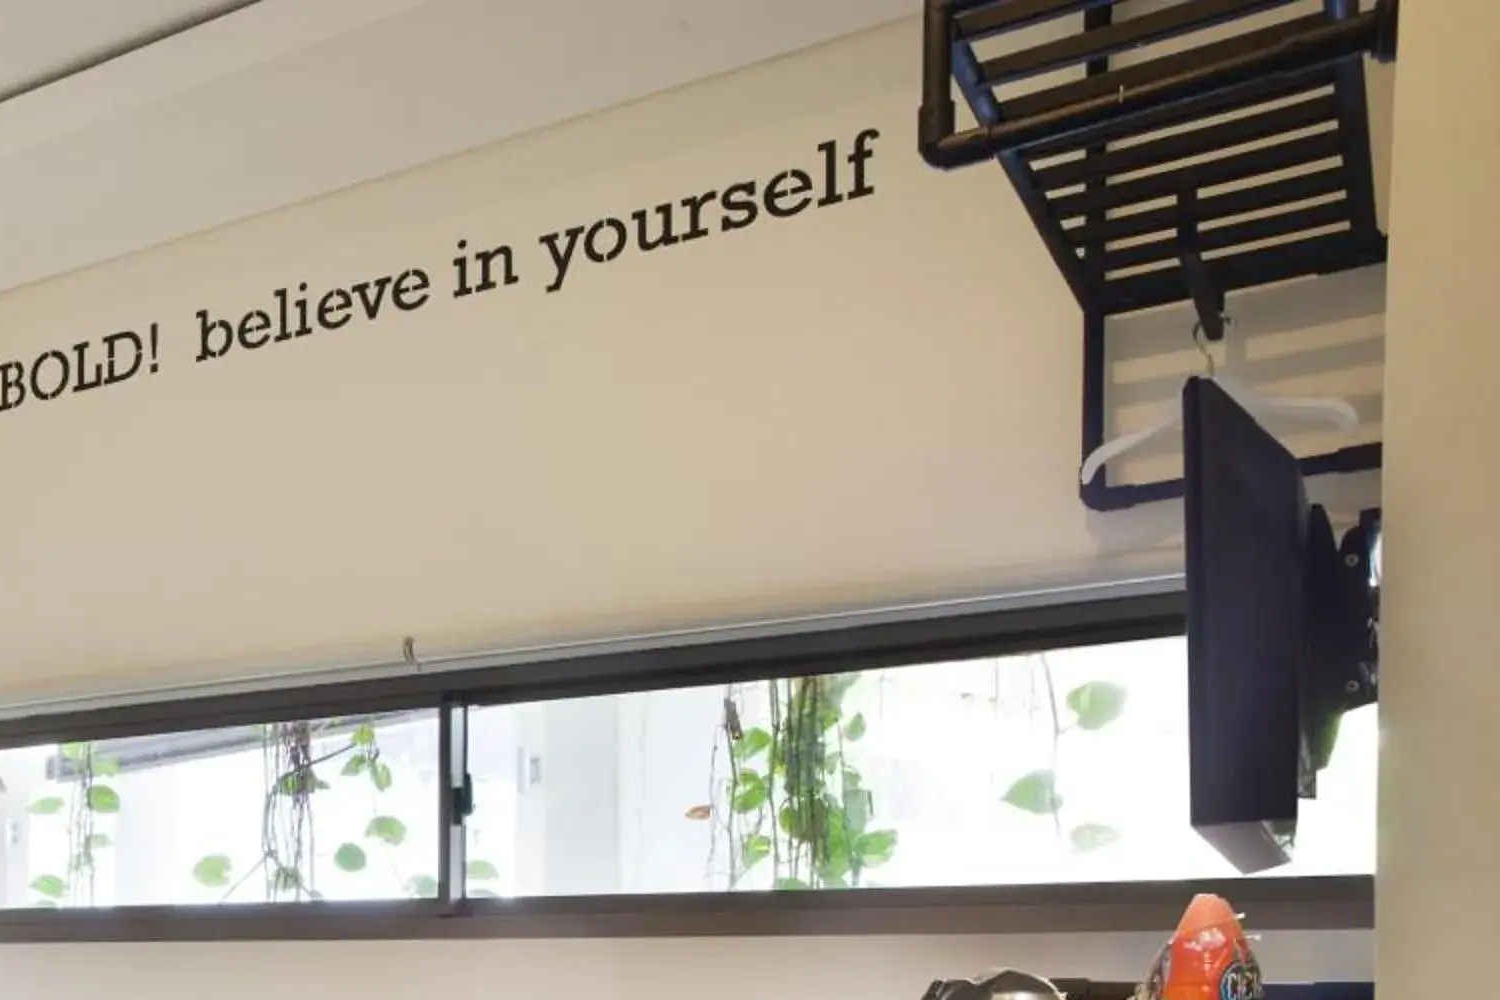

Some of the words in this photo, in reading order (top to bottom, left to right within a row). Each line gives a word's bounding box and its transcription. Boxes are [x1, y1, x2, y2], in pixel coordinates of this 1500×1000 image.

[196, 268, 430, 363] believe
[453, 240, 519, 299] in
[540, 128, 880, 293] yourself
